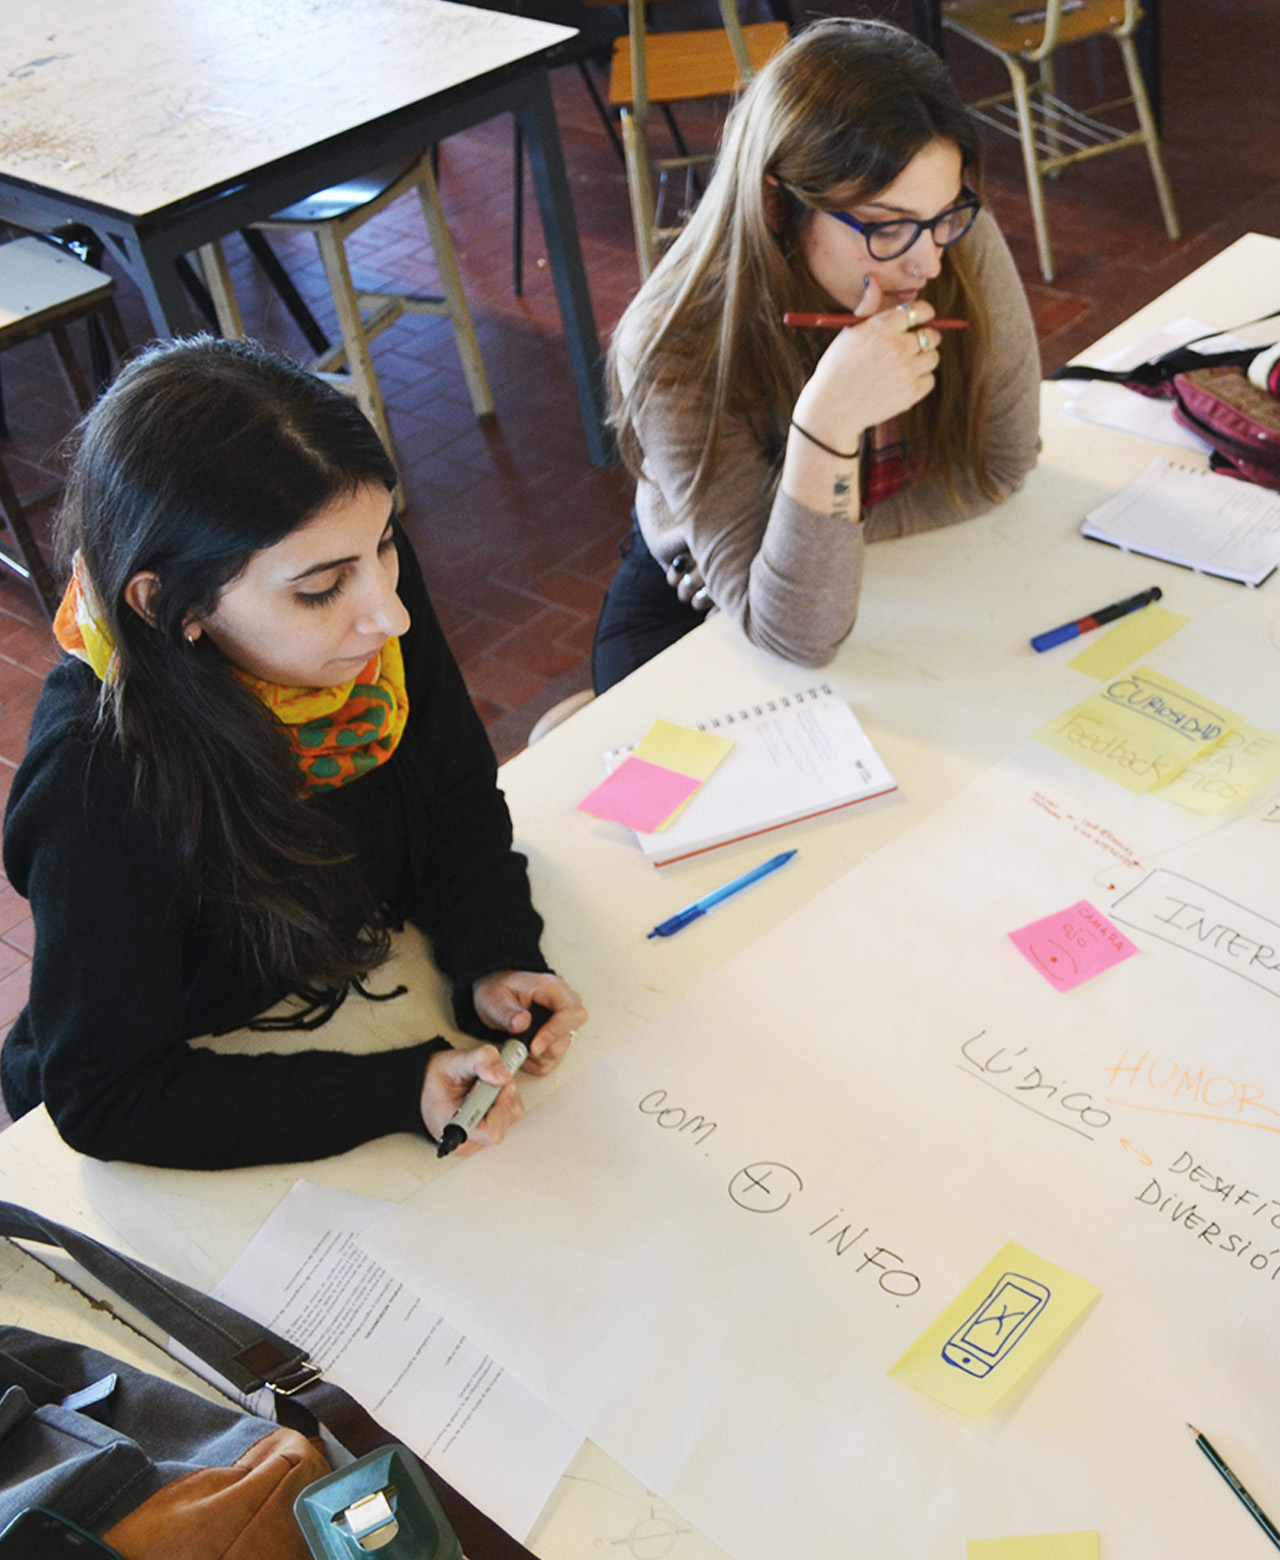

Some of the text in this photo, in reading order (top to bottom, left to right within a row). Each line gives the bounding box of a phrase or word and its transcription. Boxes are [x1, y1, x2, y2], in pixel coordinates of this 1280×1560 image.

[1106, 679, 1223, 741] CURIOSIDAD
[1055, 711, 1171, 782] Feedback
[1104, 1049, 1280, 1118] HUMOR
